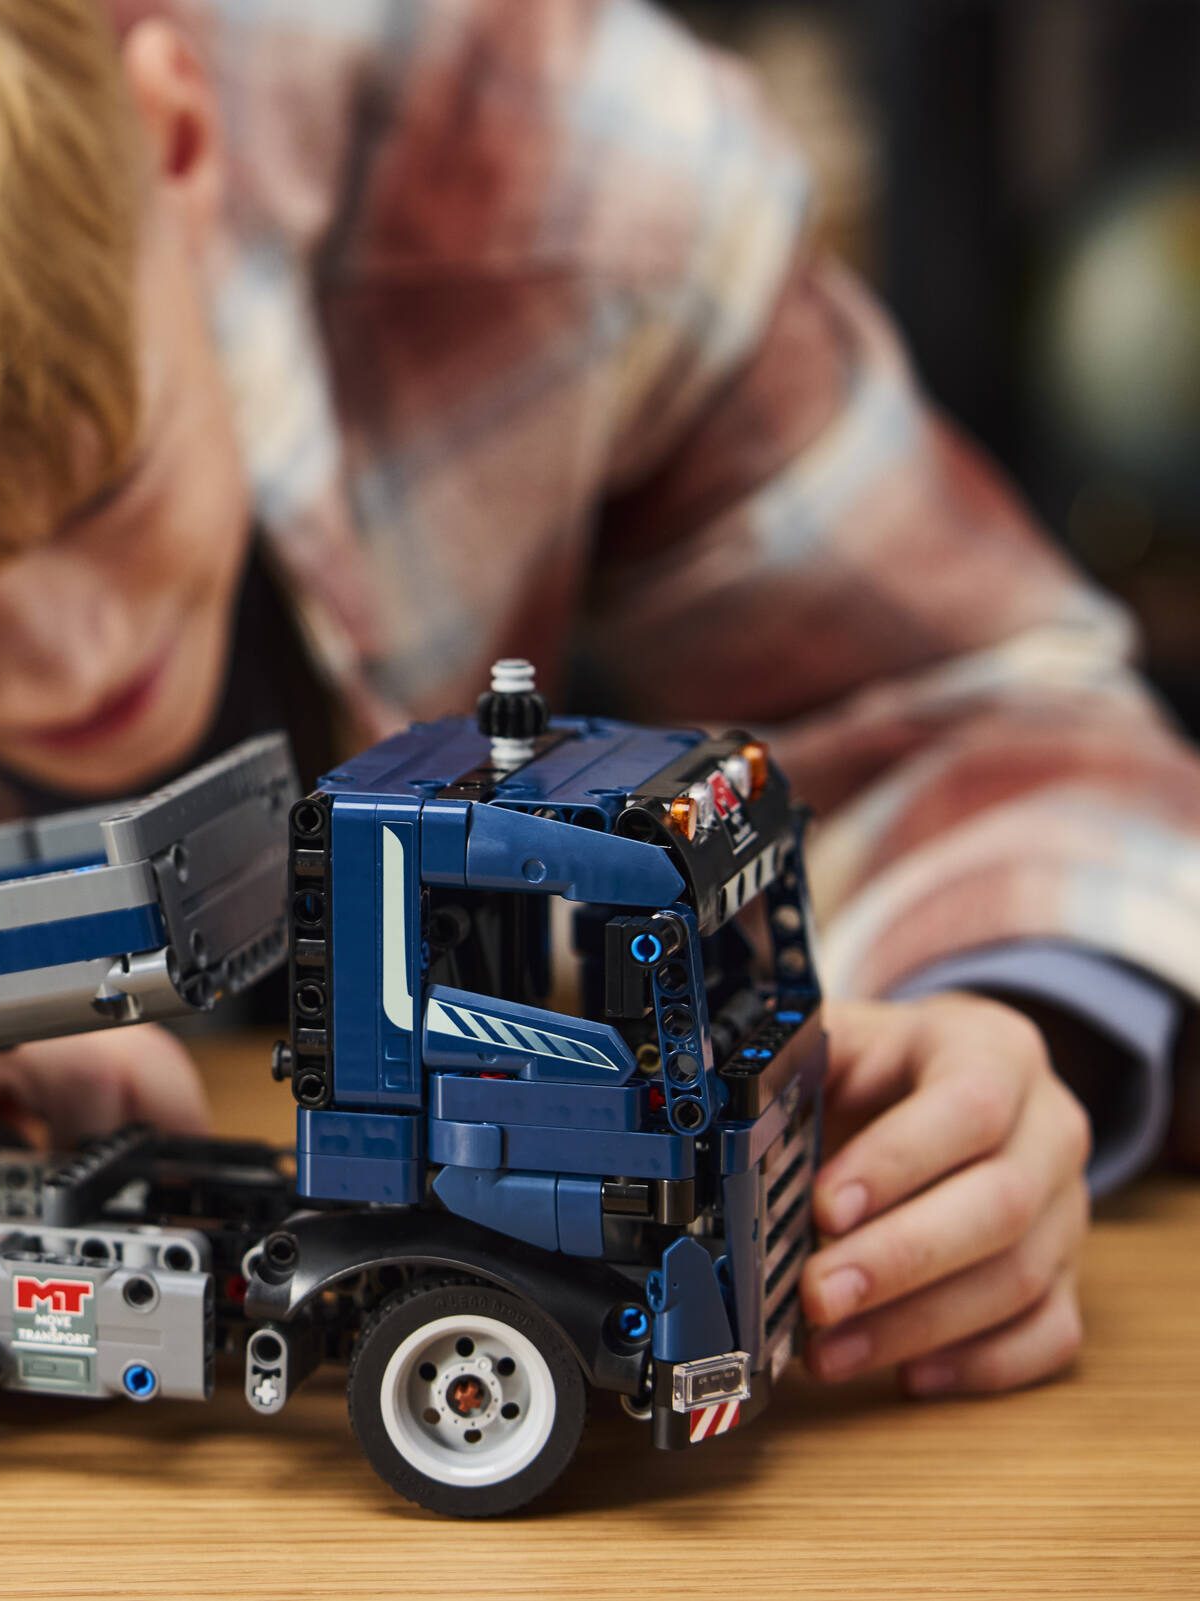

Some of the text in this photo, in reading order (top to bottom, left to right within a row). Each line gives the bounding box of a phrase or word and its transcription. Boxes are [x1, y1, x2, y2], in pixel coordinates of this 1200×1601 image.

[13, 1275, 93, 1315] MT
[35, 1313, 71, 1328] MOVE
[18, 1327, 90, 1344] TRANSPORT
